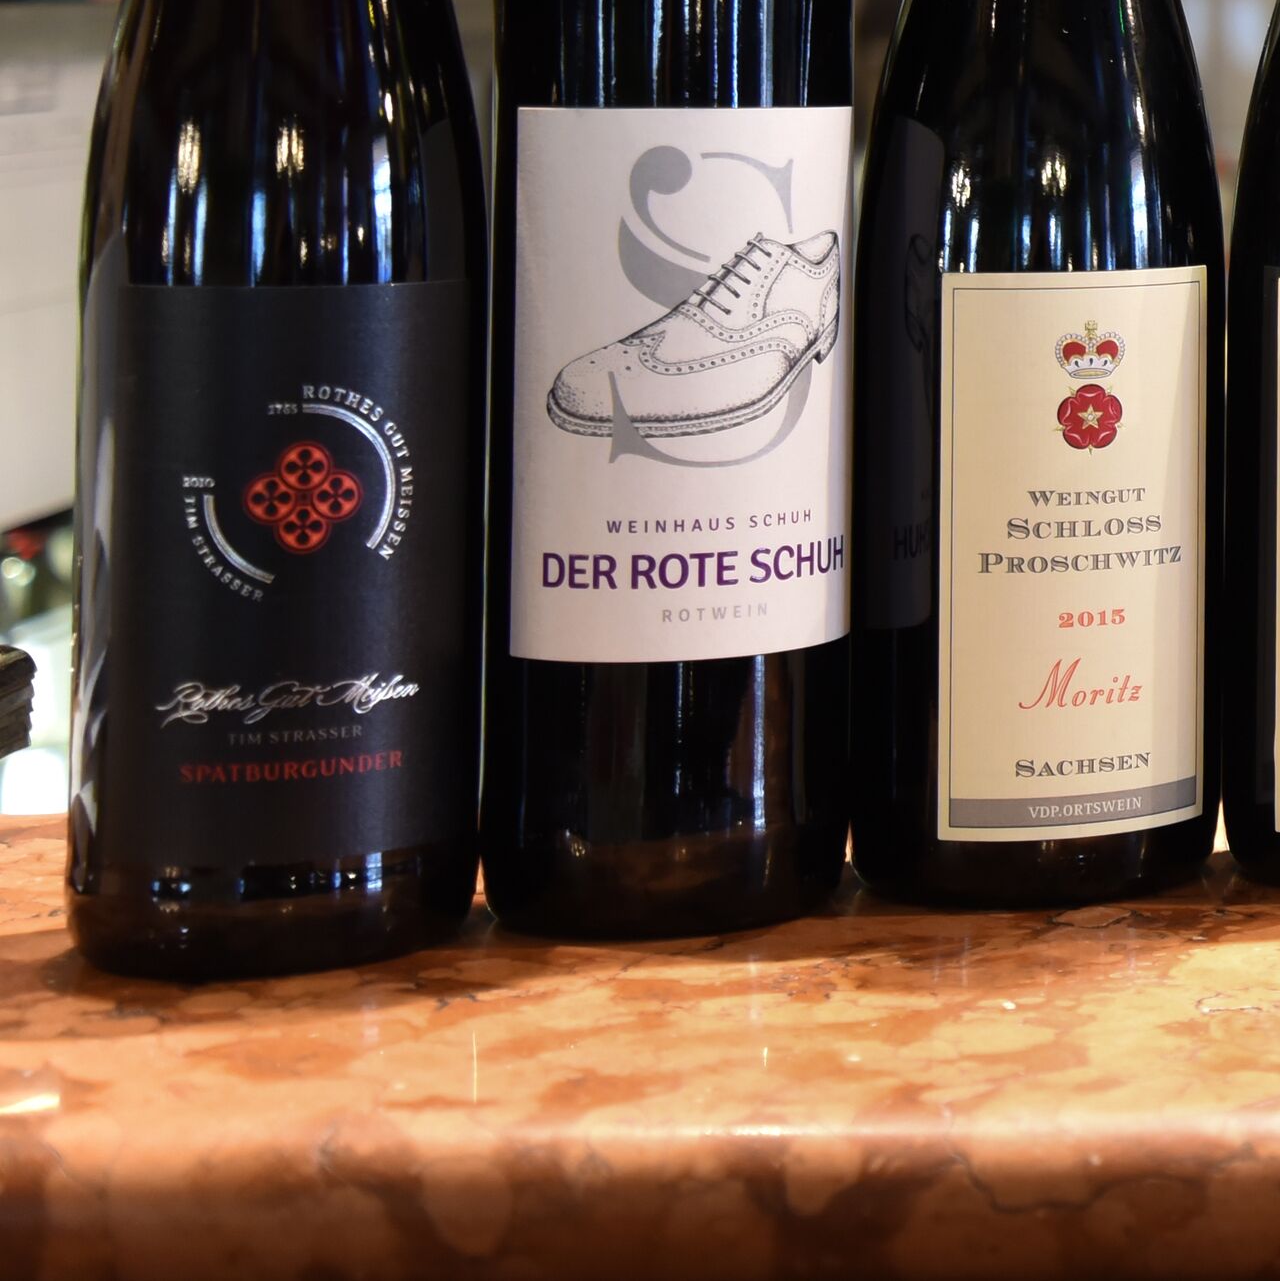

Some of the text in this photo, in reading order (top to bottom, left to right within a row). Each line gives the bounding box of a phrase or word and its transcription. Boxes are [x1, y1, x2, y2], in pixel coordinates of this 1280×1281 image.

[303, 385, 413, 560] ROTHES GUT MEISSEN
[1027, 486, 1146, 507] WEINGUT
[606, 508, 813, 535] WEINHAUS SCHUH
[1006, 514, 1162, 541] SCHLOSS
[185, 496, 264, 602] TIM STRASSER
[977, 545, 1183, 575] PROSCHWITZ
[541, 552, 617, 590] DER
[631, 550, 738, 591] ROTE
[749, 535, 845, 584] SCHUH
[662, 603, 770, 623] ROTWEIN
[1057, 608, 1127, 630] 2015
[1018, 658, 1143, 711] Moritz
[228, 724, 363, 746] TIM STRASSER
[1014, 751, 1152, 779] SACHSEN
[1028, 796, 1142, 820] VDP.ORTSWEIN
